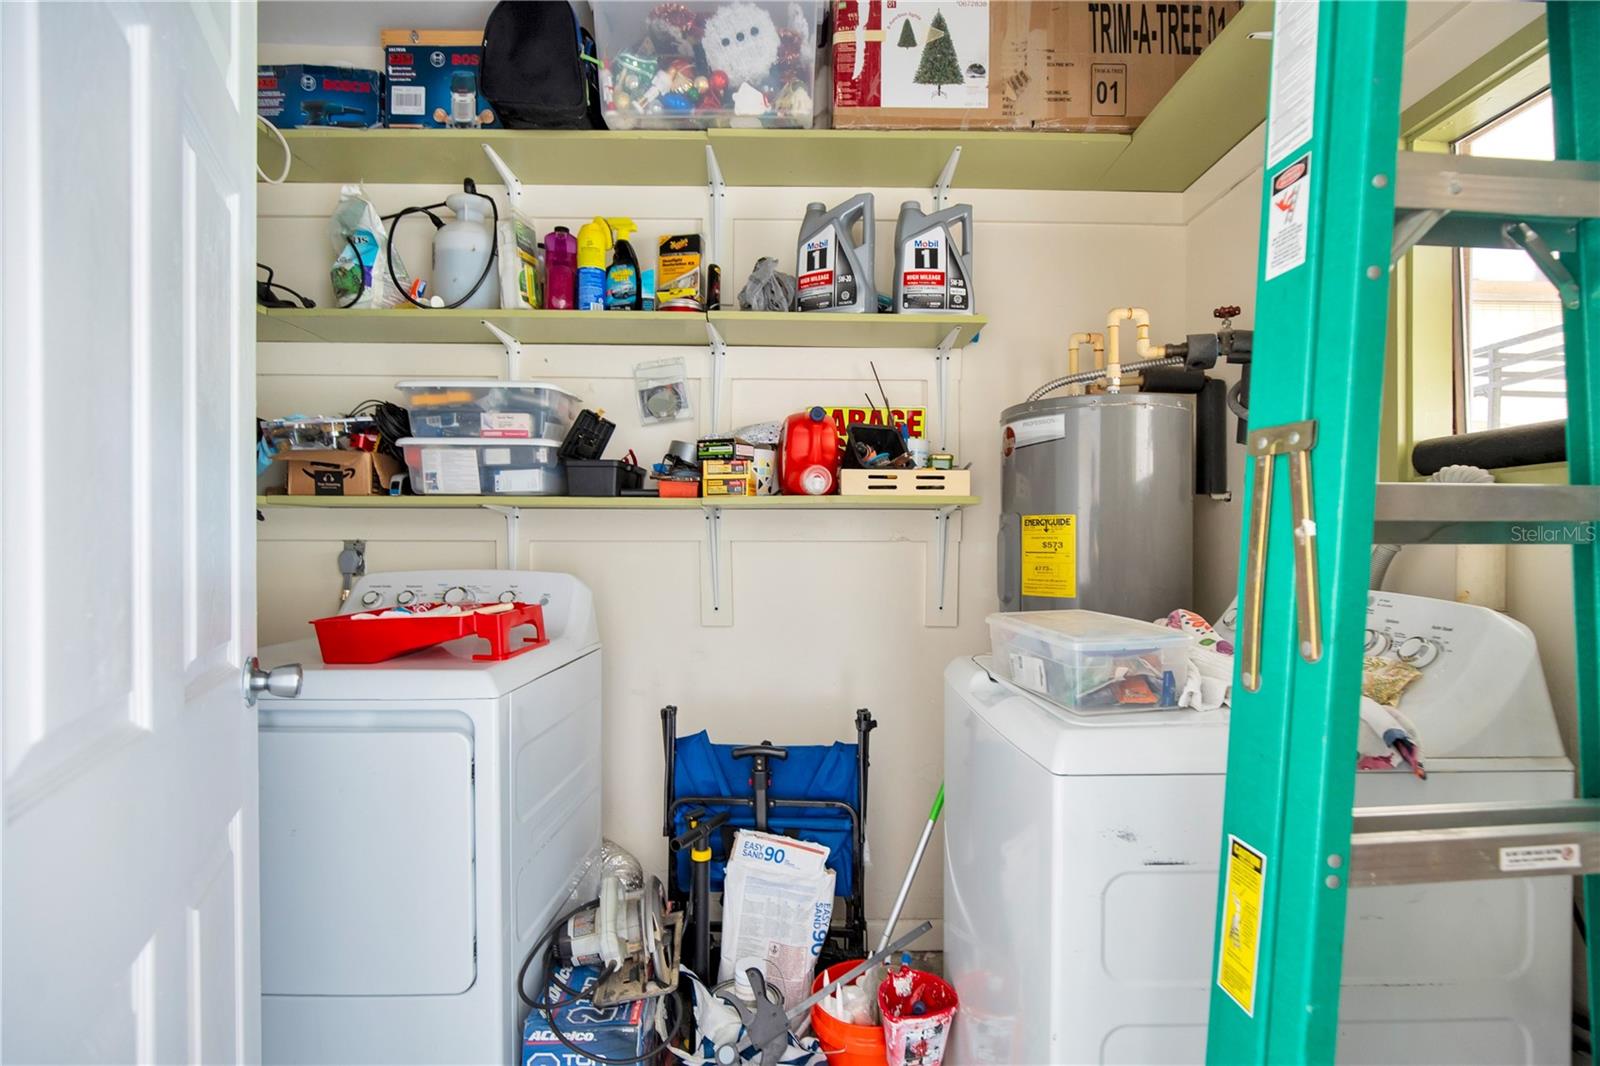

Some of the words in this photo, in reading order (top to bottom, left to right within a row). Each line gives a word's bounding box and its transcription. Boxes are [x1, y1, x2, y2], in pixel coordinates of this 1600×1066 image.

[1088, 3, 1202, 55] TRIM-A-TREE
[451, 54, 480, 66] BOS
[1097, 81, 1118, 104] 01
[807, 240, 829, 250] Mobil
[915, 240, 939, 248] Mobil
[810, 273, 830, 281] MILEAGE
[832, 409, 923, 438] ARAGE
[1042, 541, 1064, 549] $573
[744, 840, 764, 851] EASY
[742, 849, 764, 860] SAND
[764, 846, 785, 864] 90
[813, 902, 823, 929] SAND
[823, 903, 831, 927] EASY
